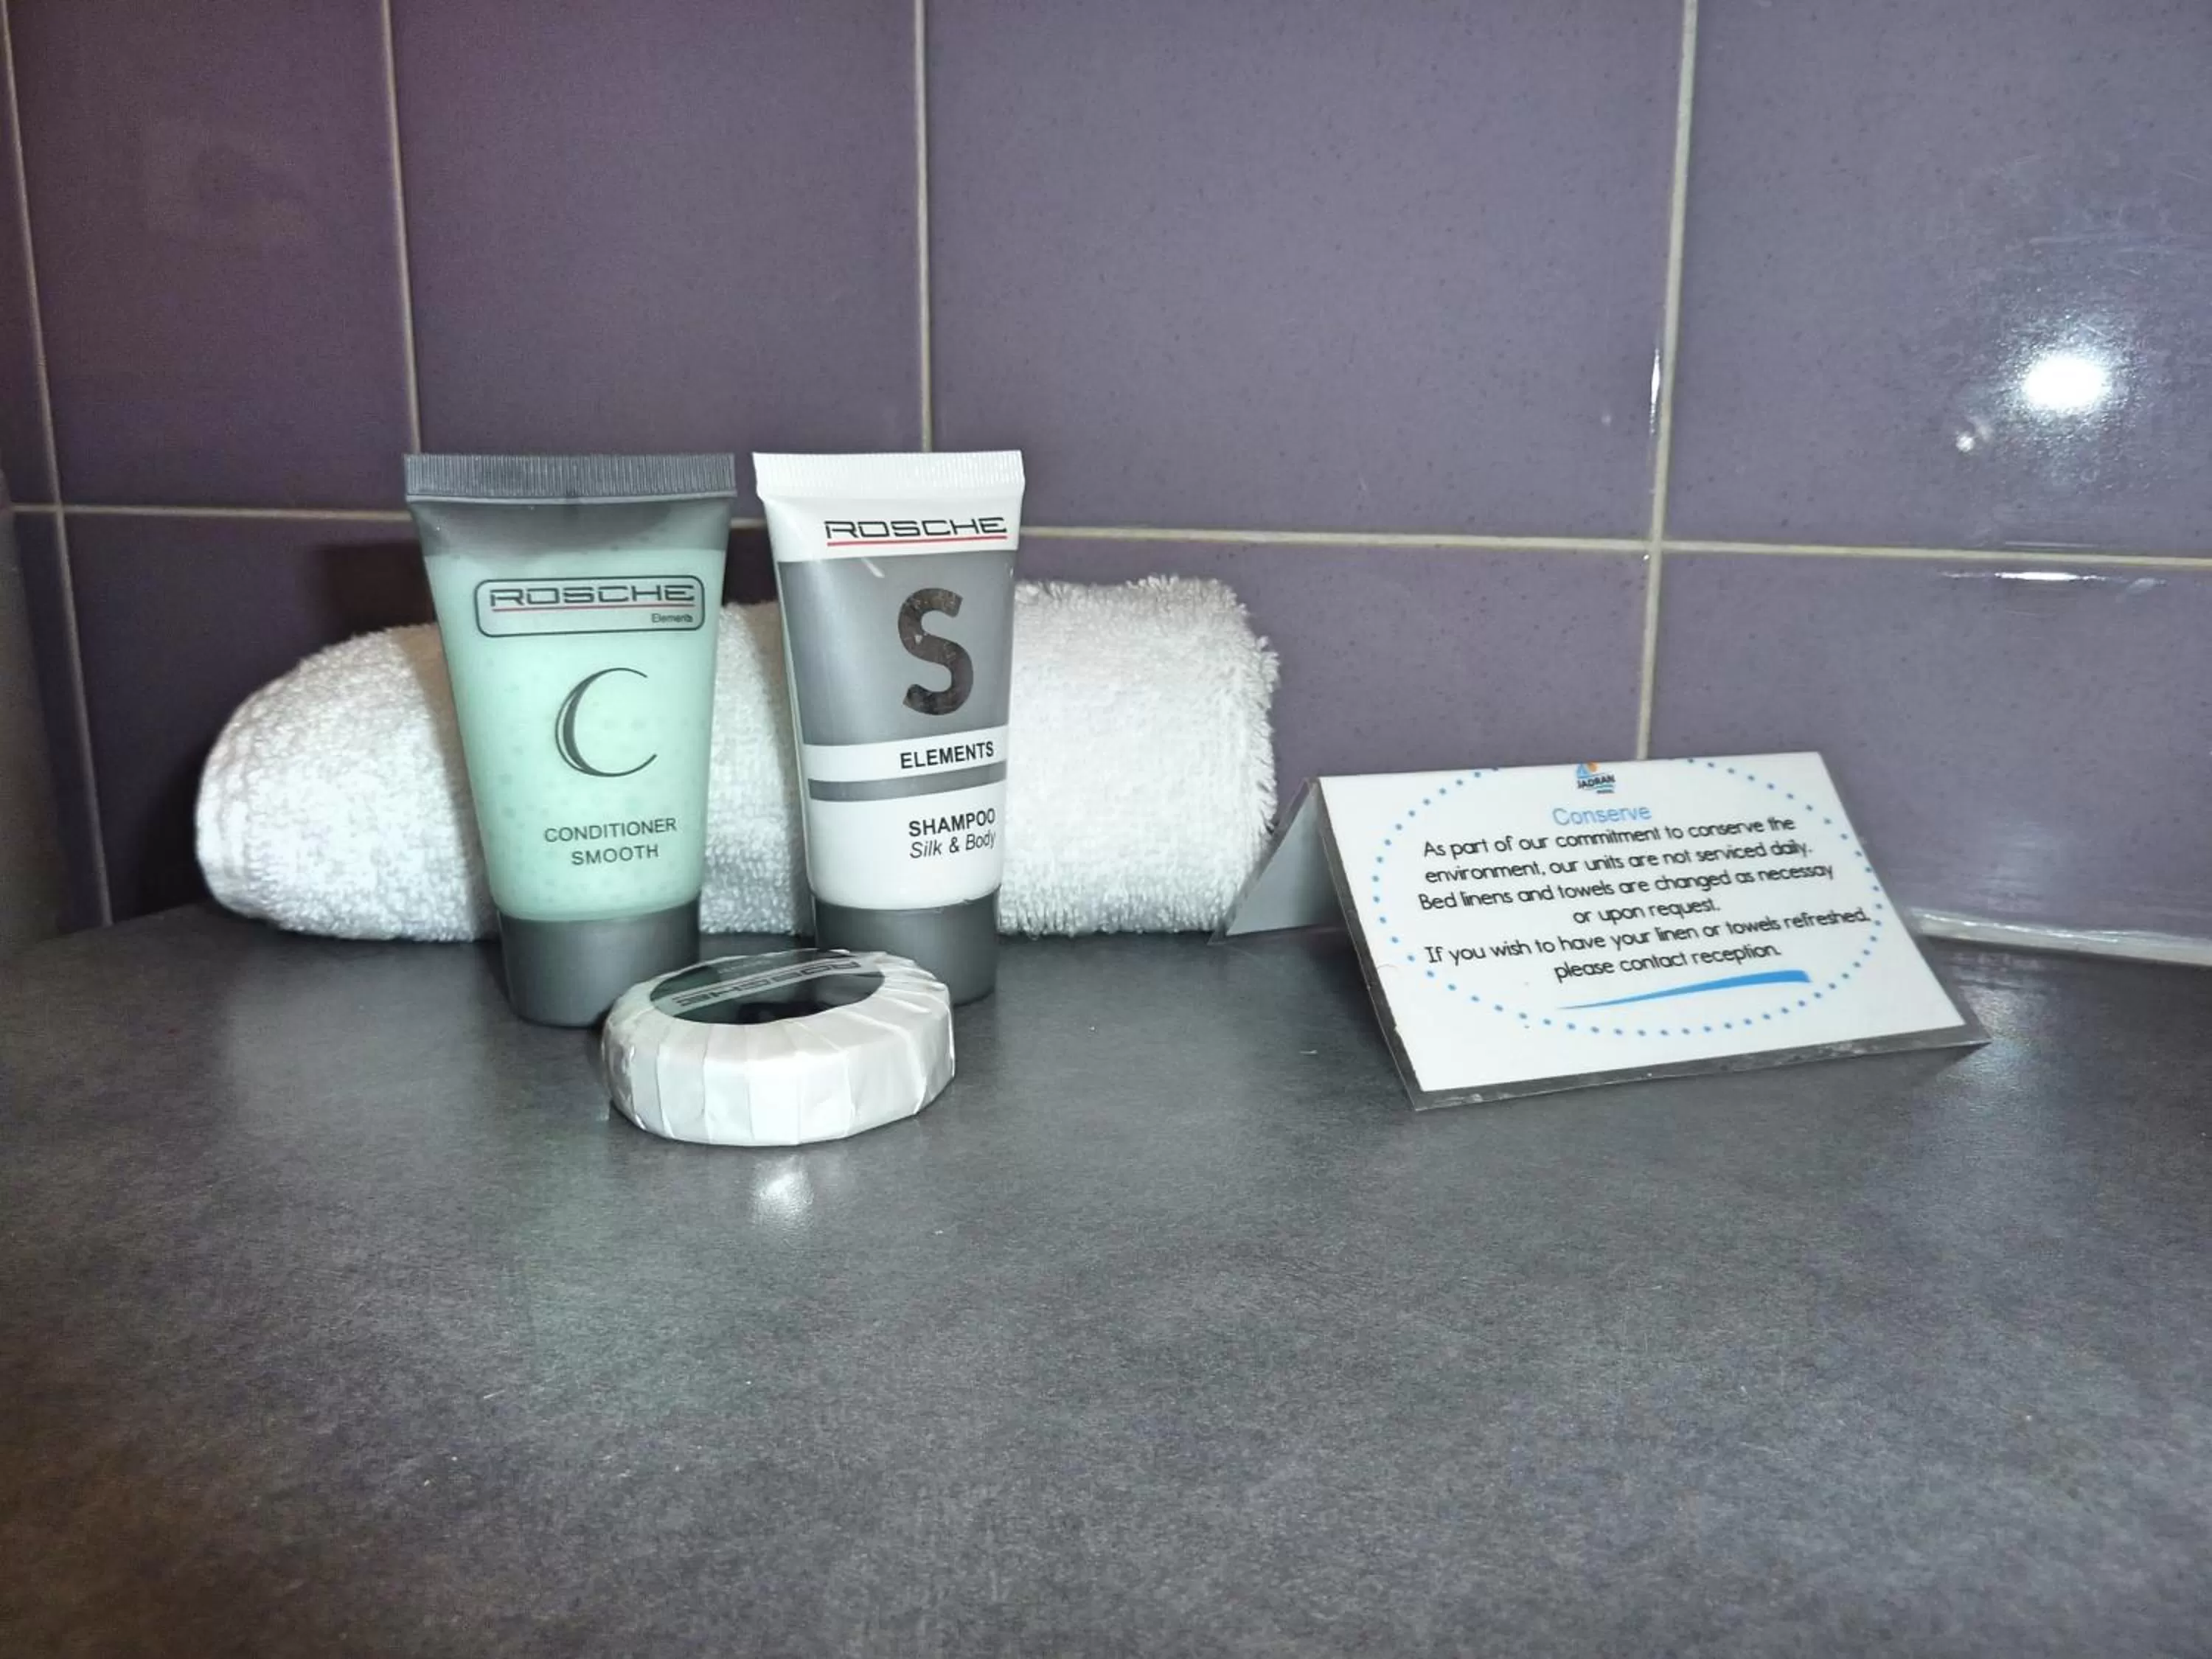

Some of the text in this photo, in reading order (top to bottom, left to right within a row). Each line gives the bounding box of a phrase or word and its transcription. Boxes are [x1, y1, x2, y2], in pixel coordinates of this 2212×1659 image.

[824, 516, 1008, 539] ROSCHE
[490, 584, 695, 607] ROSCHE
[897, 588, 974, 716] S
[554, 667, 658, 777] C
[900, 740, 995, 770] ELEMENTS
[543, 817, 678, 843] CONDITIONER
[908, 807, 996, 838] SHAMPOO
[1552, 806, 1652, 826] Conserve
[909, 828, 997, 859] Silk & Body
[1423, 815, 1797, 860] As part of our commitment to conserve the
[571, 844, 659, 866] SMOOTH
[1548, 858, 1579, 874] our
[1584, 854, 1624, 872] units
[1627, 853, 1660, 869] are
[1663, 848, 1693, 865] not
[1696, 842, 1767, 863] serviced
[1770, 838, 1814, 858] daily.
[1418, 891, 1458, 911] Bed
[1461, 889, 1514, 907] linens
[1517, 883, 1555, 902] and
[1557, 880, 1615, 900] towels
[1618, 878, 1651, 894] are
[1654, 869, 1732, 892] changed
[1735, 870, 1756, 884] as
[1572, 897, 1722, 925] or upon request.
[1424, 946, 1444, 964] If
[1447, 945, 1487, 967] you
[1489, 939, 1532, 958] wish
[1534, 938, 1556, 954] to
[1557, 934, 1607, 952] have
[1609, 929, 1651, 951] your
[1654, 925, 1700, 943] linen
[1702, 922, 1722, 938] or
[1725, 914, 1782, 935] towels
[1553, 942, 1783, 984] please contact reception.
